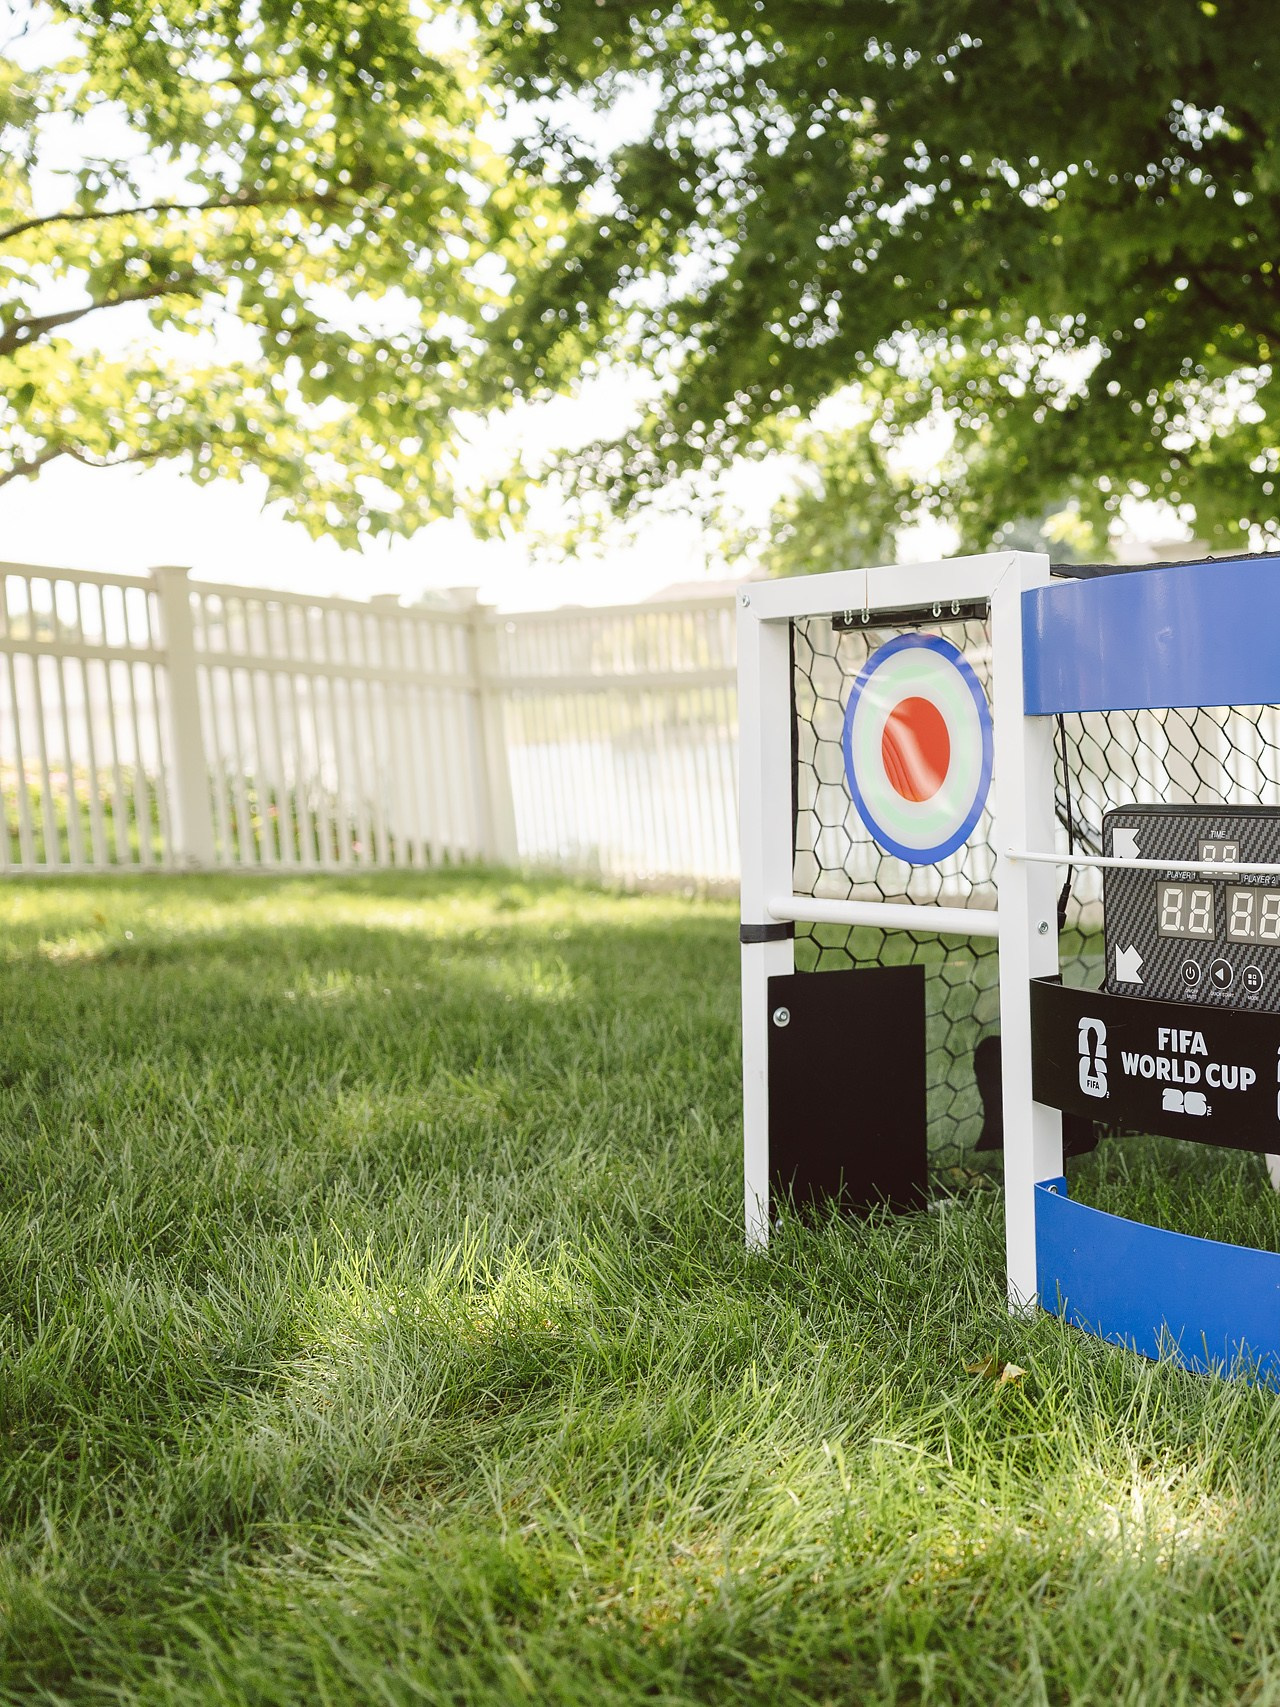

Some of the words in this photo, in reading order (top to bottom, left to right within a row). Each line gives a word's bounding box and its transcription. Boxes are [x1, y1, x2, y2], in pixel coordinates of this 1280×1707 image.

[1210, 830, 1226, 839] TIME
[1167, 871, 1191, 879] PLAYER
[1244, 875, 1268, 884] PLAYER
[1158, 1027, 1208, 1056] FIFA
[1121, 1051, 1201, 1085] WORLD
[1205, 1063, 1257, 1091] CUP
[1086, 1079, 1100, 1090] FIFA
[1162, 1088, 1207, 1116] 26
